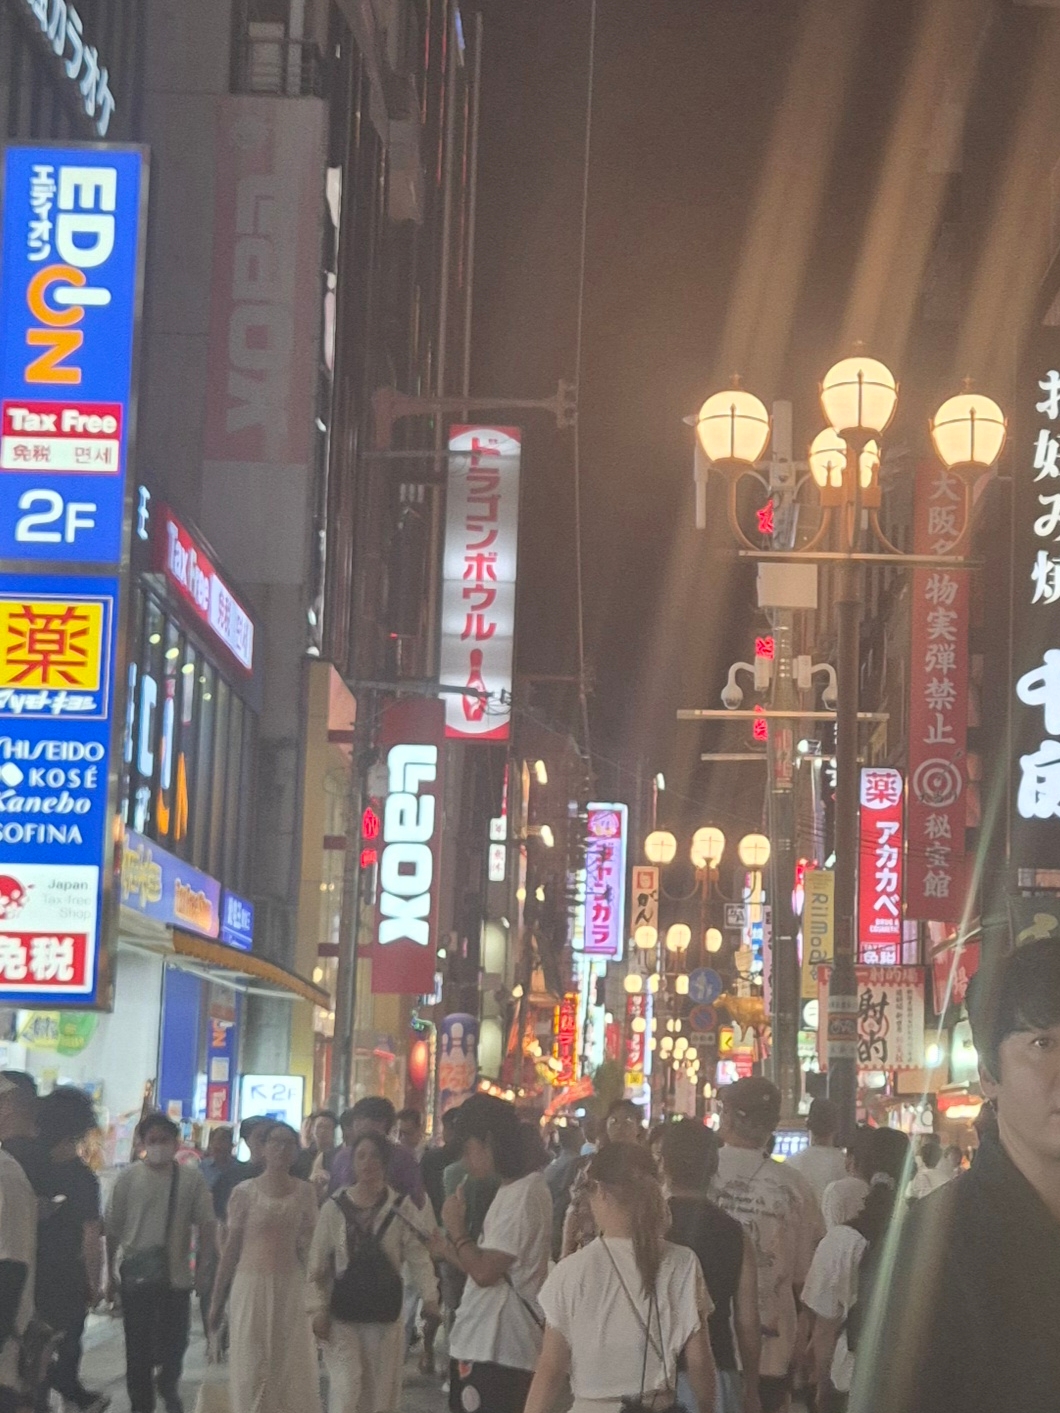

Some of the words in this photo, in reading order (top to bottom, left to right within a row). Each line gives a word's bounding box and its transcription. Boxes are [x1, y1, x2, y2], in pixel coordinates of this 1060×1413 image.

[25, 166, 118, 384] EDION
[7, 408, 57, 432] Tax
[61, 409, 118, 434] Free
[75, 446, 112, 465] 면세
[15, 488, 97, 543] 2F
[460, 437, 502, 641] ドラゴンボウル
[6, 605, 90, 687] 薬
[28, 765, 98, 789] KOSÉ
[866, 773, 898, 804] 薬
[0, 821, 83, 845] OFINA
[923, 814, 952, 898] 秘宝館
[873, 821, 900, 916] アカカベ
